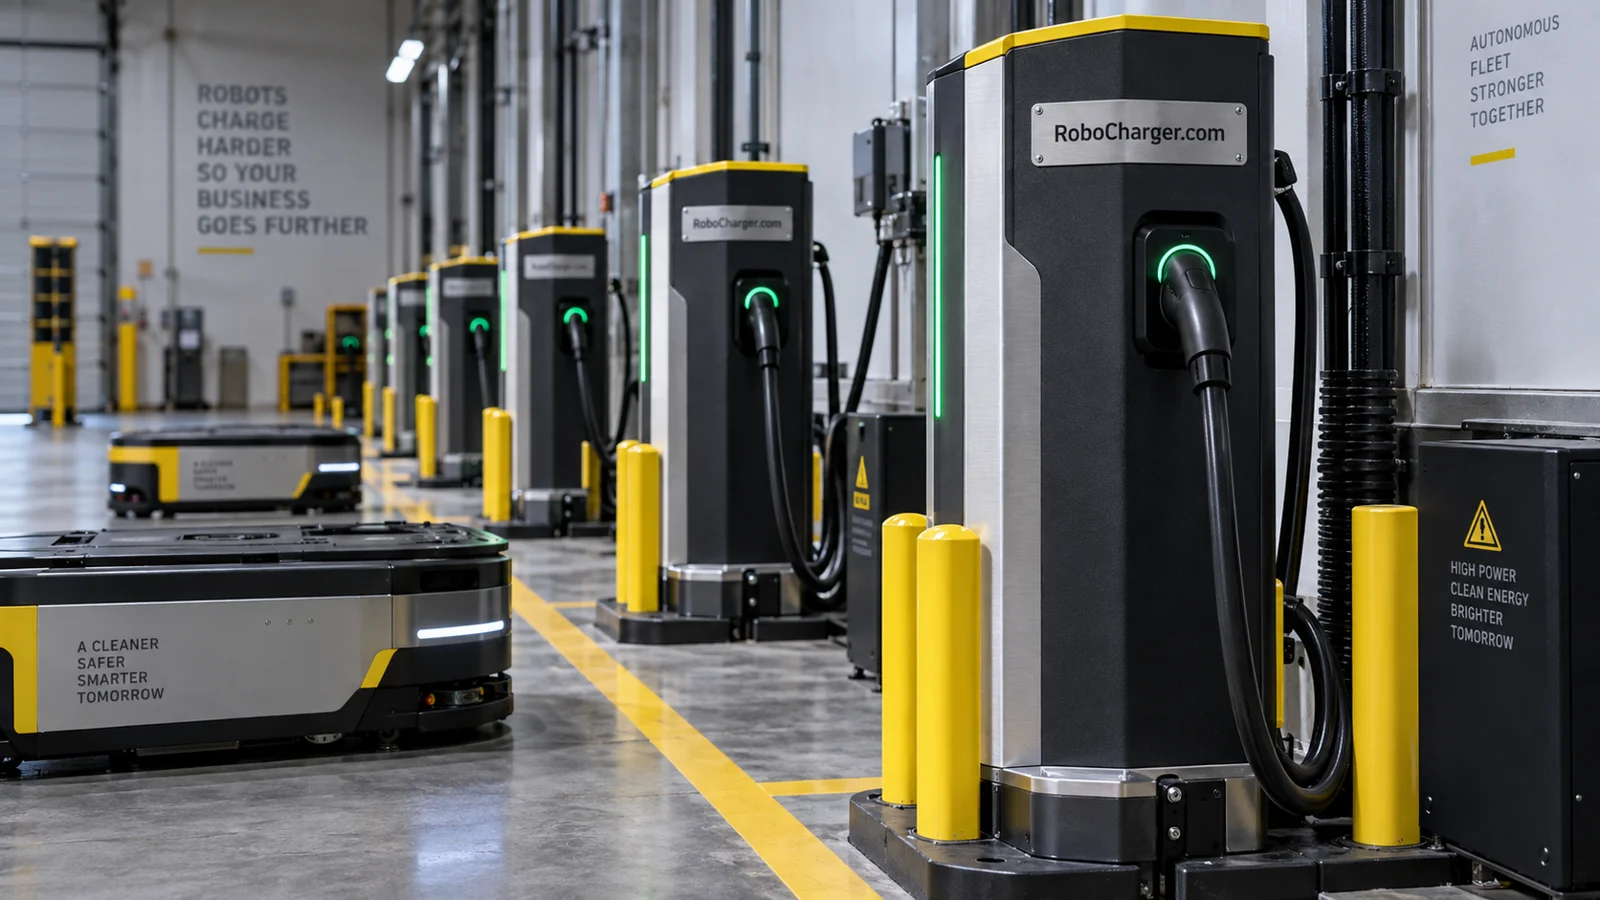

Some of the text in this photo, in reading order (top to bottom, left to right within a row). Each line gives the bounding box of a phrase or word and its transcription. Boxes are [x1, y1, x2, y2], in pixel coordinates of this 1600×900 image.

[1470, 14, 1560, 52] AUTONOMOUS
[1470, 52, 1511, 77] FLEET
[198, 85, 288, 105] ROBOTS
[1470, 71, 1544, 103] STRONGER
[198, 111, 289, 131] CHARGE
[1470, 97, 1544, 128] TOGETHER
[1055, 121, 1225, 146] RoboCharger.com
[198, 137, 291, 157] HARDER
[198, 163, 297, 183] SO YOUR
[198, 189, 311, 209] BUSINESS
[198, 215, 368, 235] GOES FURTHER
[693, 217, 782, 231] RoboCharger.com
[1450, 560, 1516, 583] HIGH POWER
[1450, 581, 1529, 607] CLEAN ENERGY
[1450, 603, 1503, 626] BRIGHTER
[77, 638, 159, 653] A CLEANER
[1450, 624, 1514, 650] TOMORROW
[77, 656, 125, 670] SAFER
[77, 671, 148, 687] SMARTER
[77, 687, 165, 704] TOMORROW
